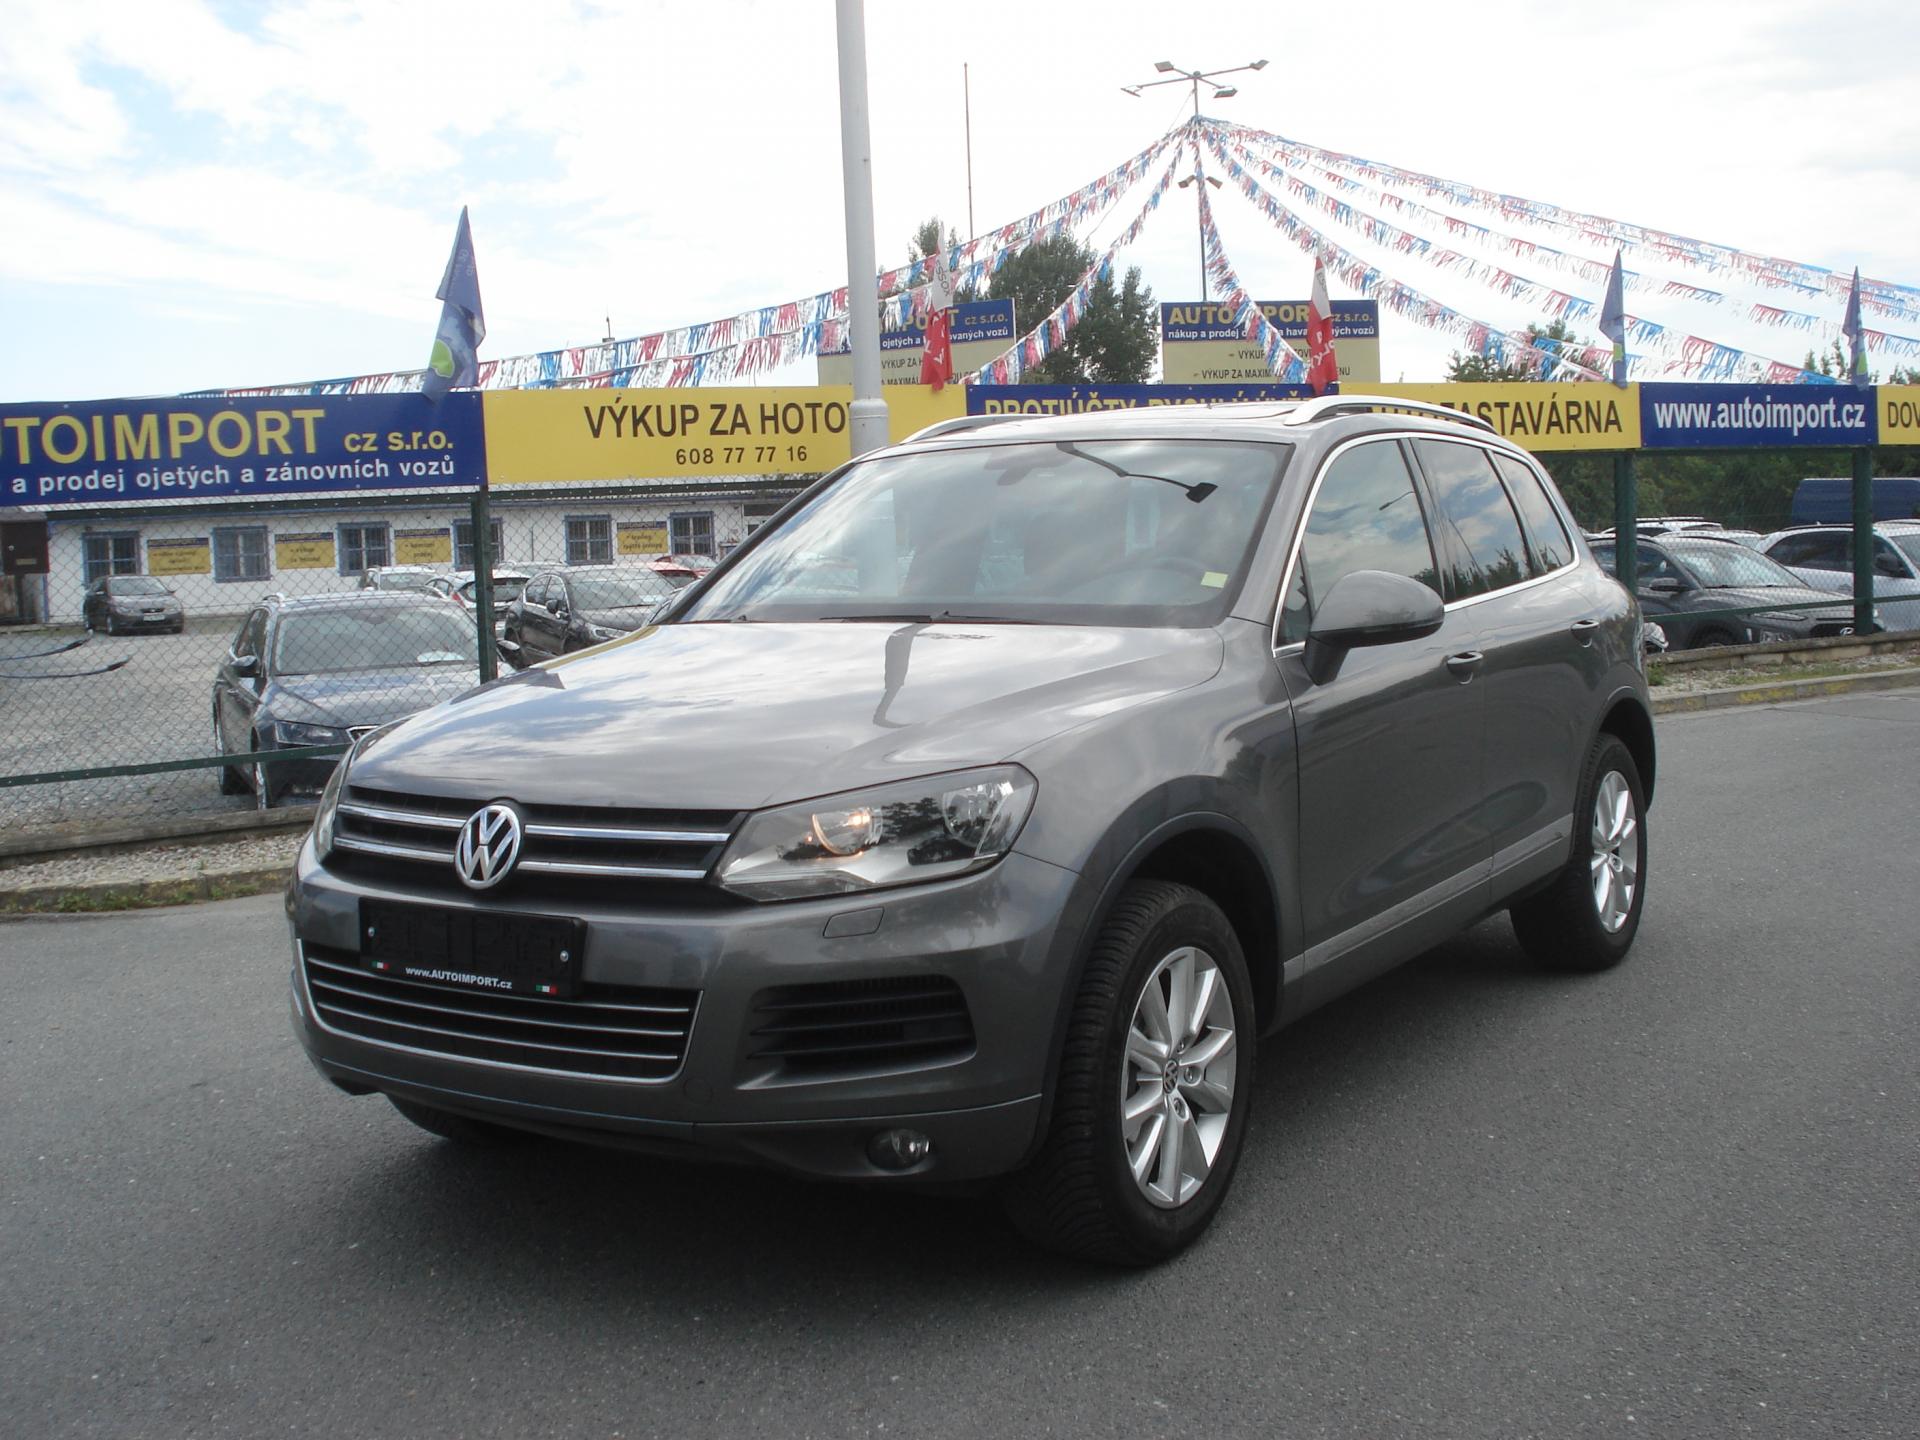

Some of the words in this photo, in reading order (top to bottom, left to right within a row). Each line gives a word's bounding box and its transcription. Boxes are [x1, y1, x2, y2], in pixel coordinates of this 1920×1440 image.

[965, 316, 977, 326] cz
[980, 313, 1008, 324] s.r.o.
[1168, 305, 1309, 325] AUTOPOR
[1344, 313, 1373, 322] s.r.o.
[882, 336, 914, 348] ojetých
[986, 326, 1008, 337] vozů
[1168, 328, 1198, 339] nákup
[1209, 328, 1239, 339] prodej
[1286, 327, 1351, 337] havaých
[1352, 325, 1375, 335] vozů
[907, 357, 917, 367] ZA
[1232, 369, 1243, 379] ZA
[584, 396, 700, 438] VÝKUP
[709, 404, 752, 436] ZA
[760, 402, 851, 435] HOTO
[1654, 395, 1865, 437] www.autoimport.cz
[0, 408, 325, 465] TOIMPORT
[344, 431, 377, 453] cz
[388, 430, 454, 451] s.r.o.
[676, 447, 714, 465] 608
[723, 447, 746, 465] 77
[754, 446, 777, 463] 77
[786, 445, 807, 462] 16
[12, 478, 27, 494] a
[39, 467, 125, 497] prodej
[136, 464, 230, 491] ojetých
[241, 468, 255, 484] a
[265, 459, 389, 483] zánovních
[400, 454, 455, 477] vozů
[405, 966, 513, 990] www.AUTOIMPORT.cz
